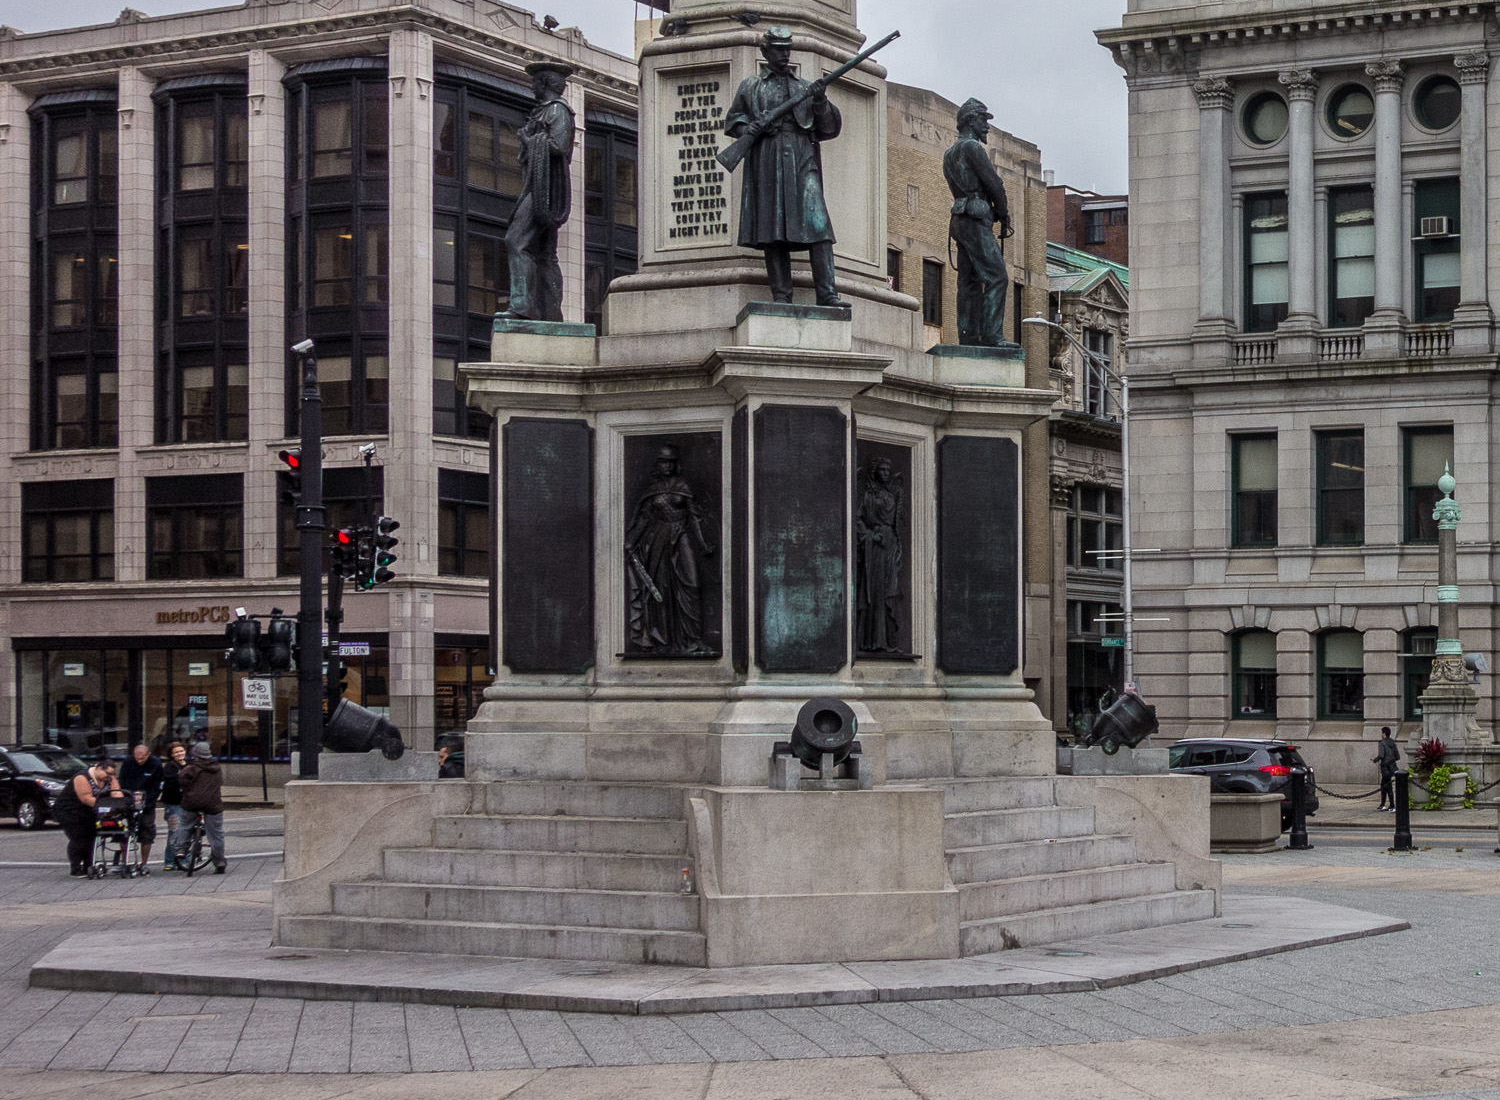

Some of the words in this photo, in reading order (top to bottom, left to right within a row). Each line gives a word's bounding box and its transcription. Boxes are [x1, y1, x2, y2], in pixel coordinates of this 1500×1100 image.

[677, 81, 720, 96] ERECTED
[681, 97, 694, 108] BY
[697, 95, 716, 106] THE
[674, 108, 707, 122] PEOPLE
[711, 107, 723, 117] OF
[667, 122, 697, 135] RHODE
[698, 120, 725, 132] ISLAN
[682, 136, 694, 146] TO
[697, 133, 716, 145] THE
[678, 146, 719, 159] MEMORY
[681, 162, 693, 172] OF
[696, 160, 716, 171] THE
[673, 173, 702, 186] BRAVE
[704, 171, 724, 183] MEN
[673, 188, 694, 198] WHO
[698, 185, 722, 197] DIED
[671, 200, 694, 212] THAT
[697, 197, 727, 210] THEIR
[676, 211, 722, 225] COUNTRY
[669, 226, 700, 238] MIGHT
[703, 223, 728, 236] LIVE
[155, 605, 230, 624] metroPCS
[340, 646, 365, 655] FULTON
[188, 695, 208, 704] FREE
